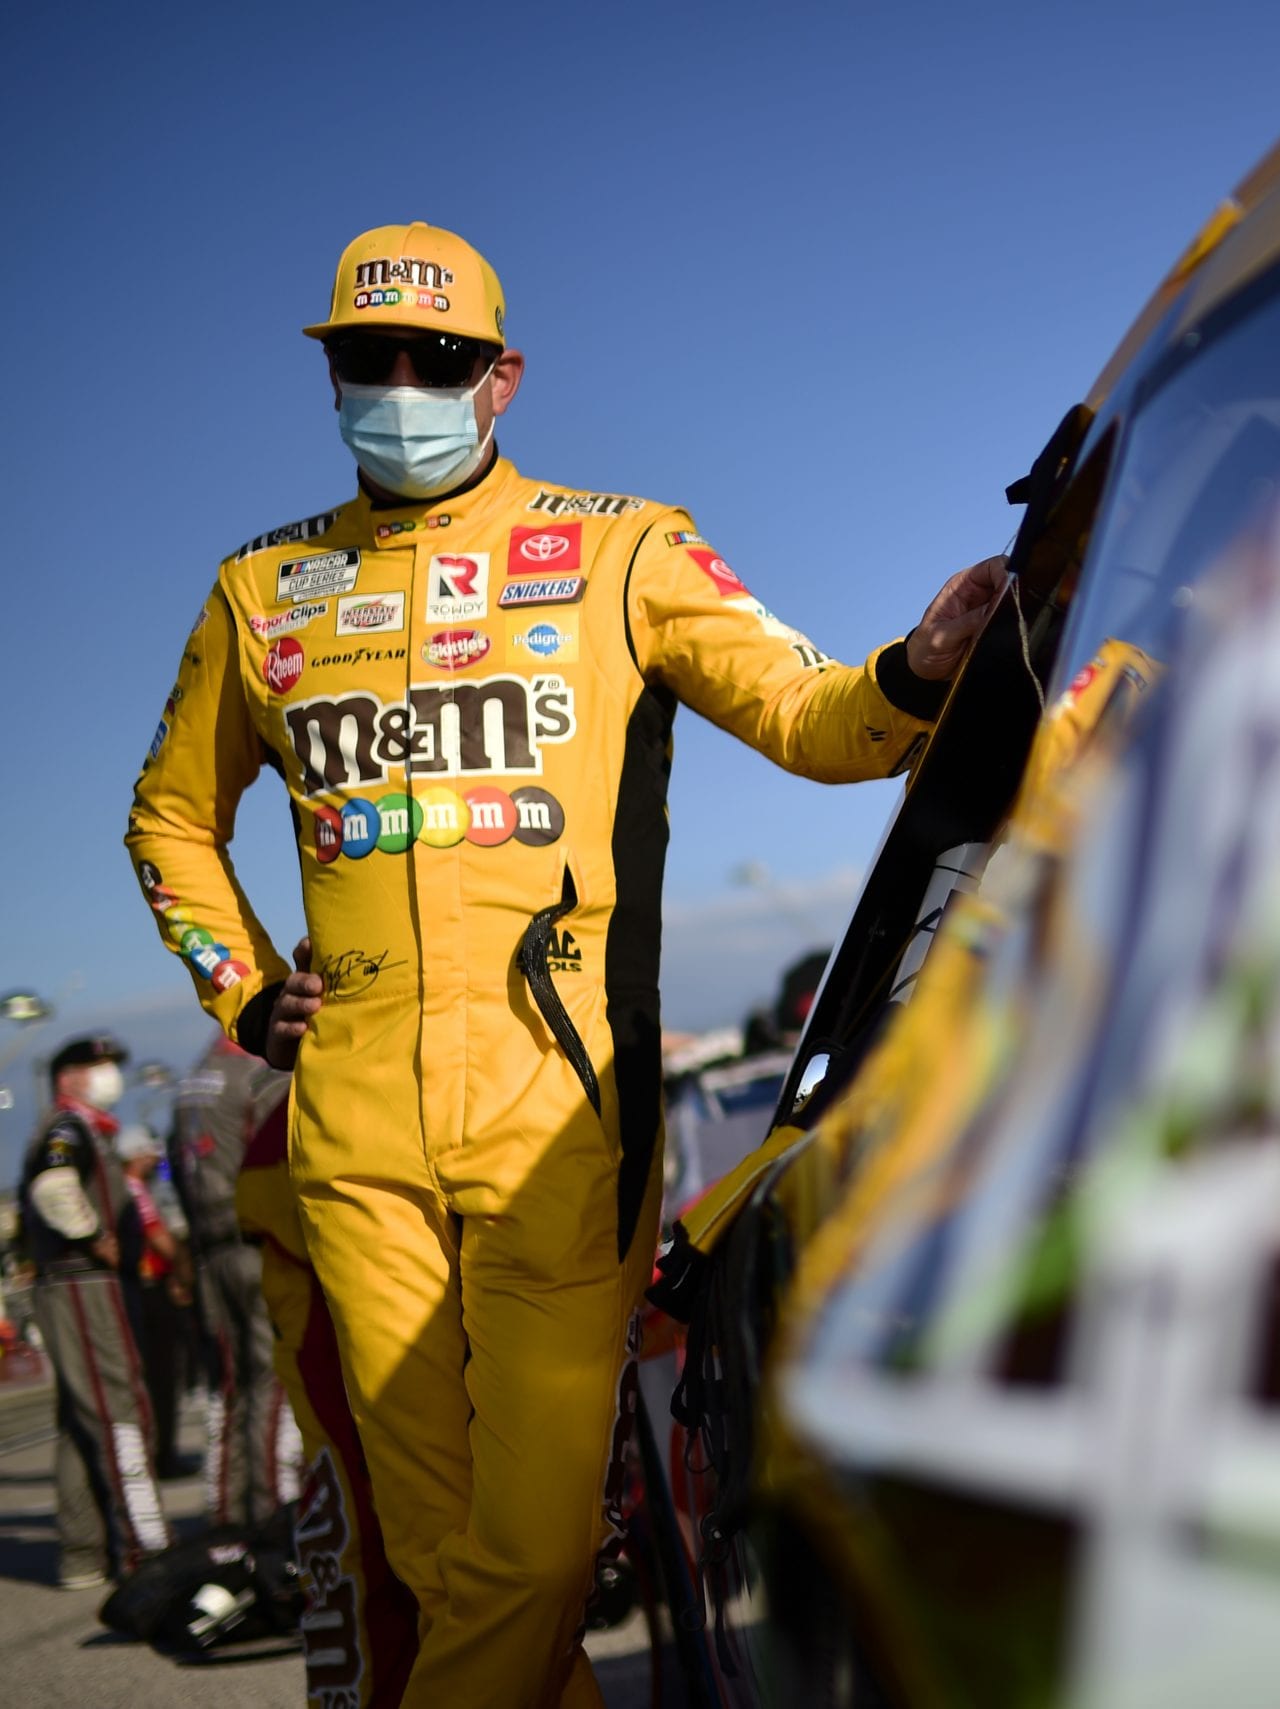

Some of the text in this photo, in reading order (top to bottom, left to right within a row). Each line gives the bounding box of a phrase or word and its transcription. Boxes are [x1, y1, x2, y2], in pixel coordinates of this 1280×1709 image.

[307, 553, 348, 573] NASCAR
[289, 569, 345, 591] CUP SERIES
[503, 579, 577, 601] SNICKERS
[342, 605, 397, 620] INTERSTATE
[429, 602, 484, 616] ROWDY
[342, 614, 394, 627] BATTERIES
[512, 629, 573, 648] Pedigree
[266, 641, 303, 688] Rheem
